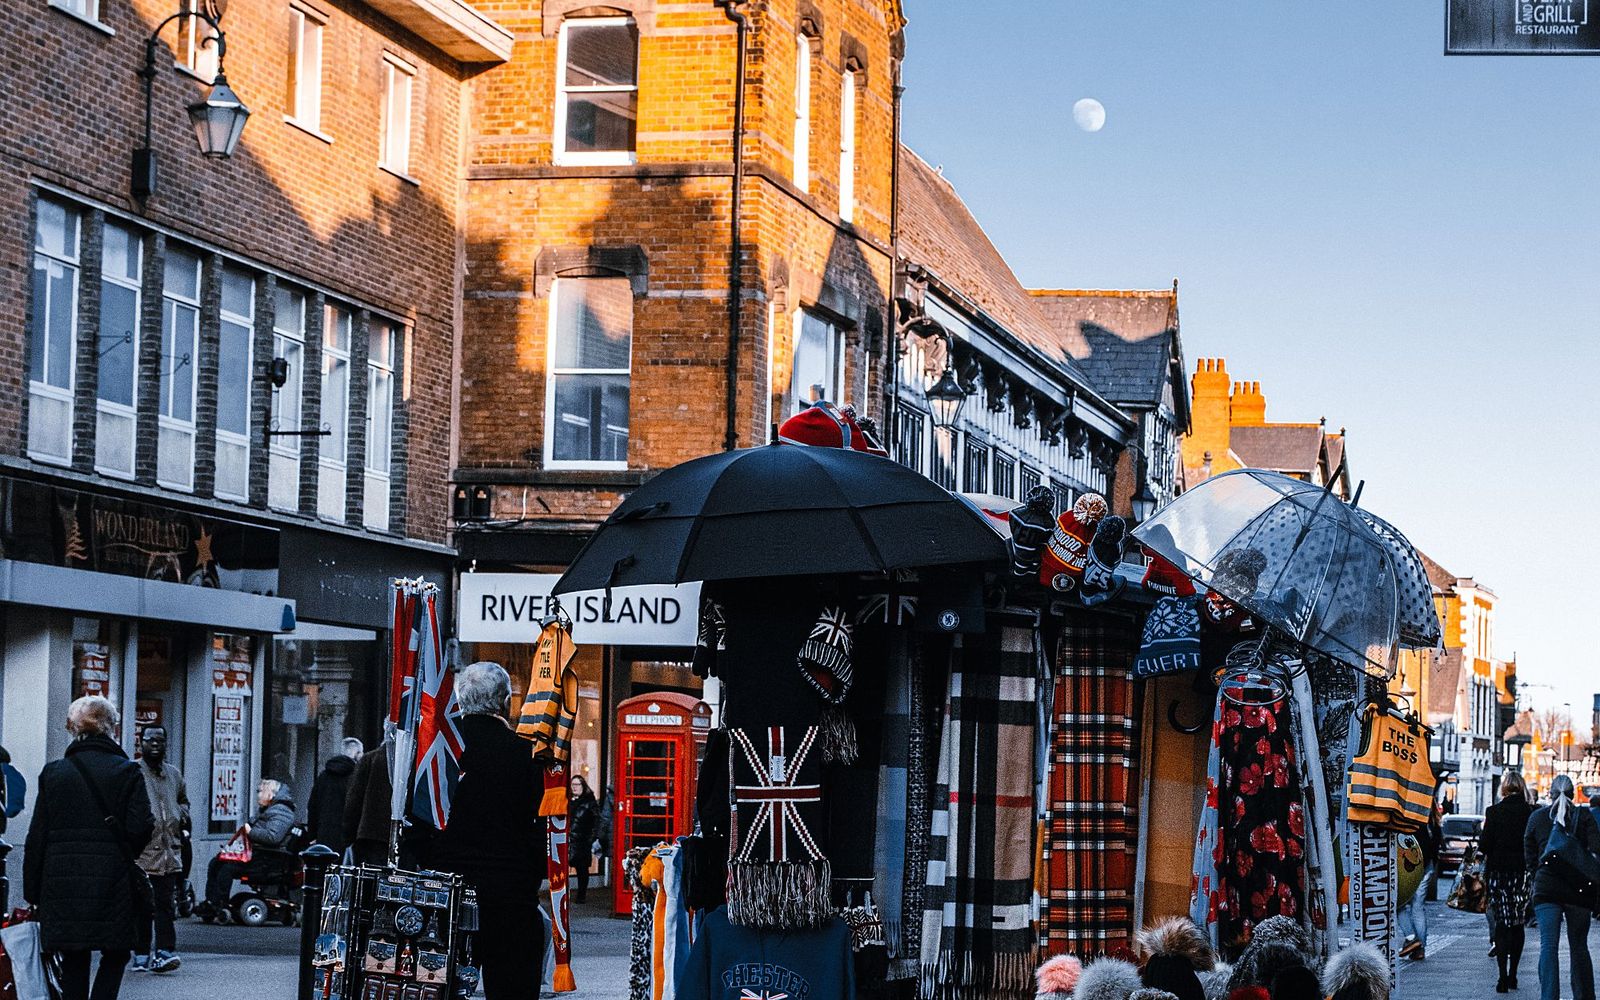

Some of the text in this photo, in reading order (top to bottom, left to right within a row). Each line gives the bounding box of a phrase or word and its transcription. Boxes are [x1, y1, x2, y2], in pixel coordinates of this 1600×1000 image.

[1522, 4, 1533, 23] AND
[1533, 5, 1575, 23] GRILL
[1515, 25, 1579, 35] RESTAURANT
[93, 509, 190, 550] WONDERLAND
[575, 596, 681, 624] ISLAND
[630, 715, 678, 724] TELEPHONE
[1388, 727, 1414, 748] THE
[1382, 740, 1418, 764] BOSS
[1353, 871, 1361, 921] WORLD
